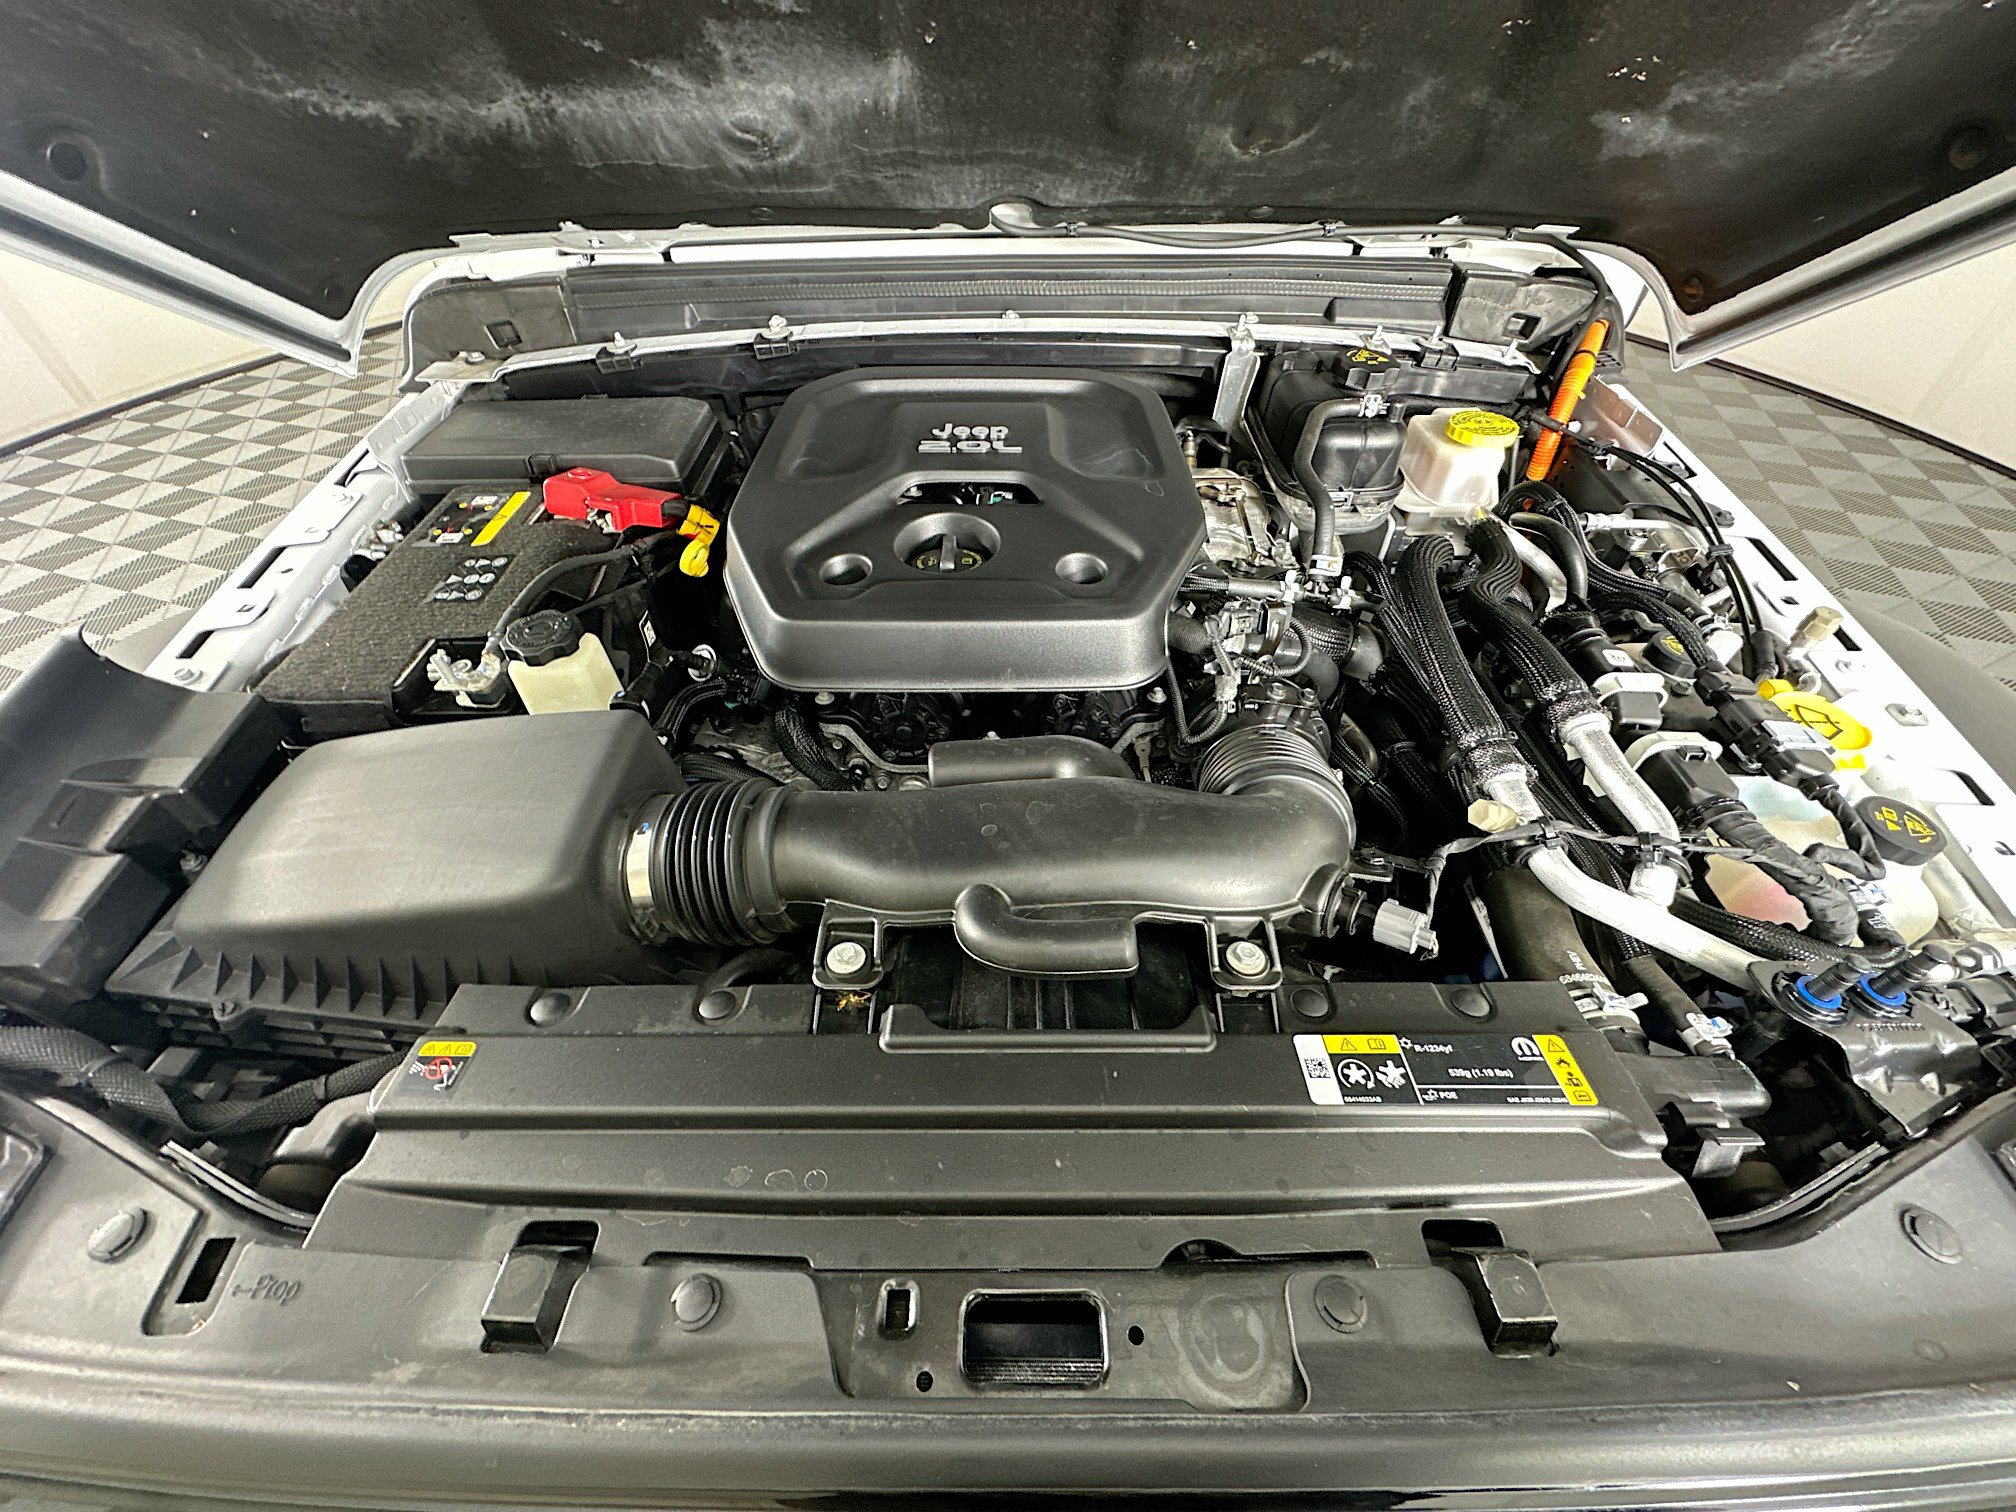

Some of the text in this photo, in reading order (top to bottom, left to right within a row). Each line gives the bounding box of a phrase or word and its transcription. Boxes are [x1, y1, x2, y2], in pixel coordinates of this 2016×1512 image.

[931, 422, 1009, 441] Jeep
[918, 440, 1023, 454] 2.0L
[1447, 1068, 1514, 1079] 539g (1.19 lbs)
[1439, 1091, 1458, 1100] POE
[249, 1273, 301, 1307] Prop
